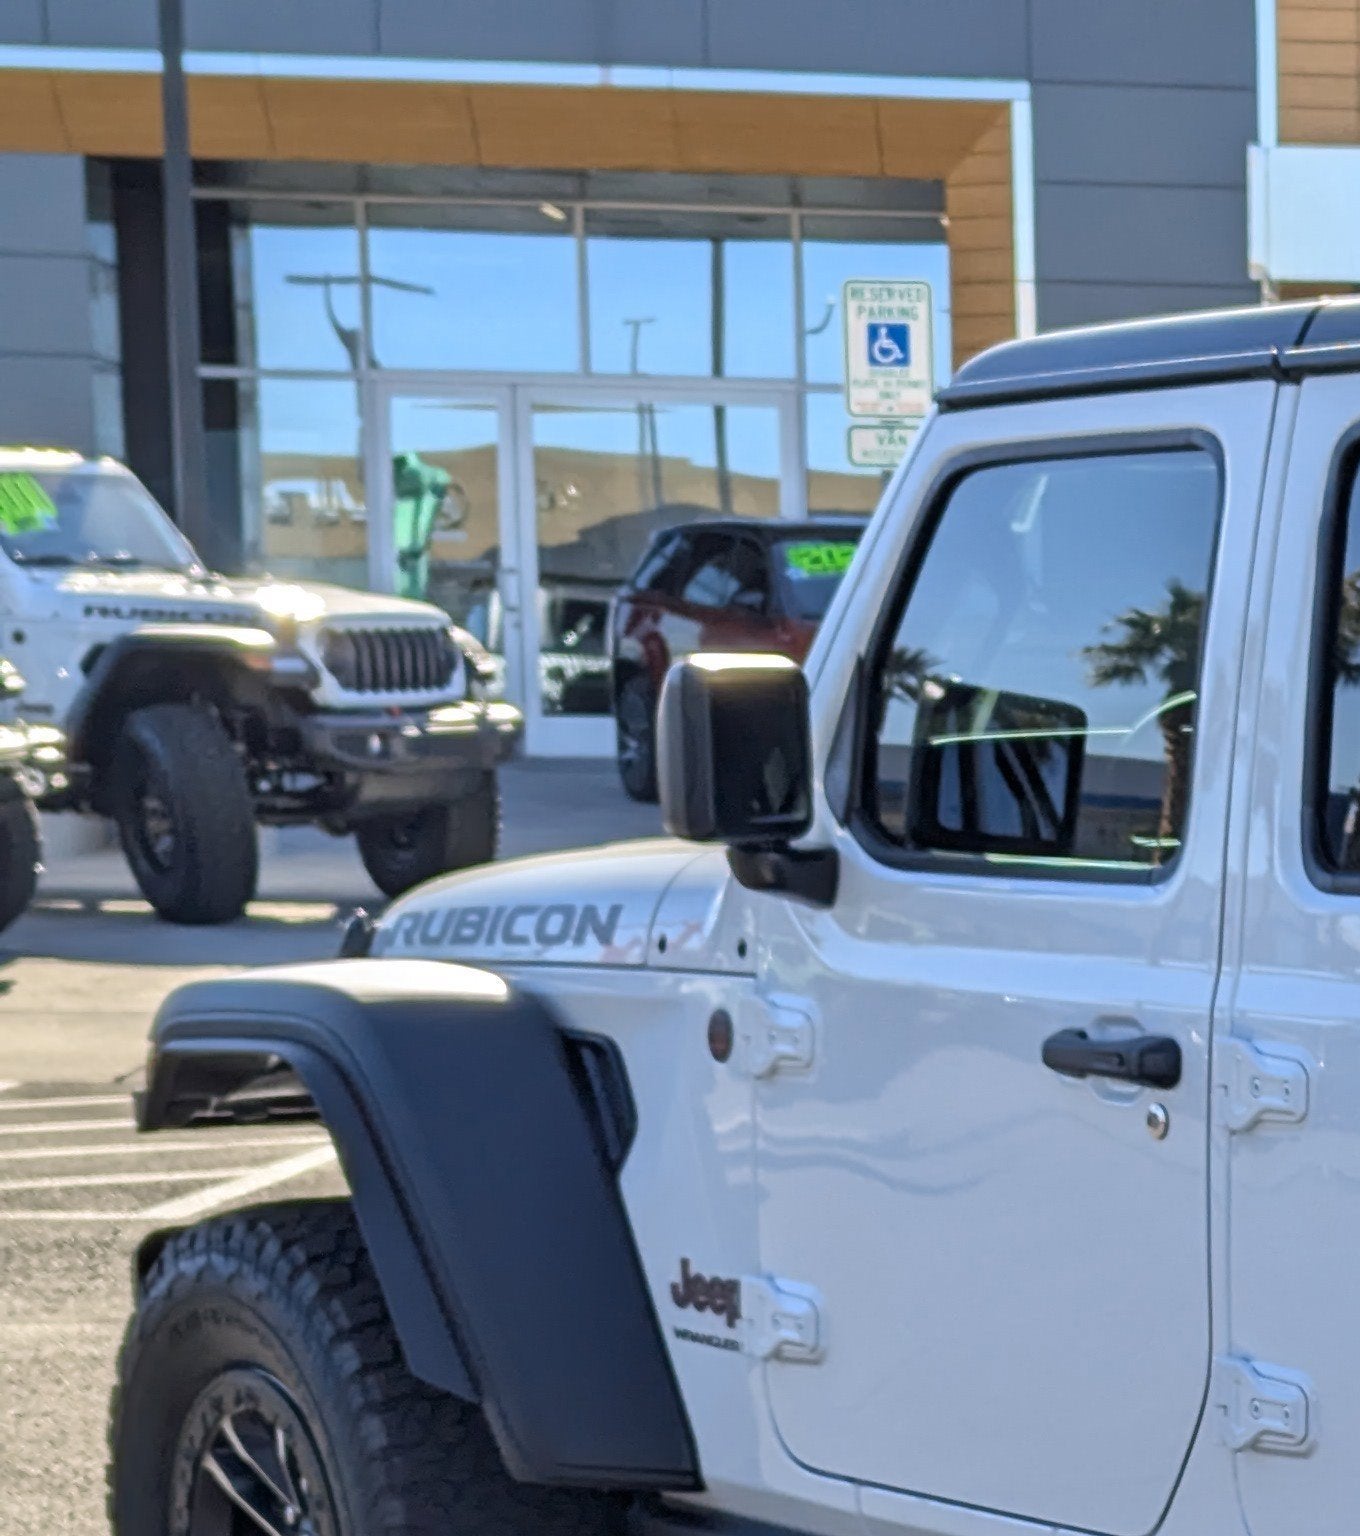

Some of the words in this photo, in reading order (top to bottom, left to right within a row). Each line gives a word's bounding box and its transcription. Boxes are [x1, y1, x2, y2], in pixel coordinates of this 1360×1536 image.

[850, 286, 924, 303] RESERVED
[856, 305, 920, 321] PARKING
[876, 432, 908, 446] VAN
[386, 902, 624, 948] RUBICON
[670, 1256, 743, 1329] Jeep
